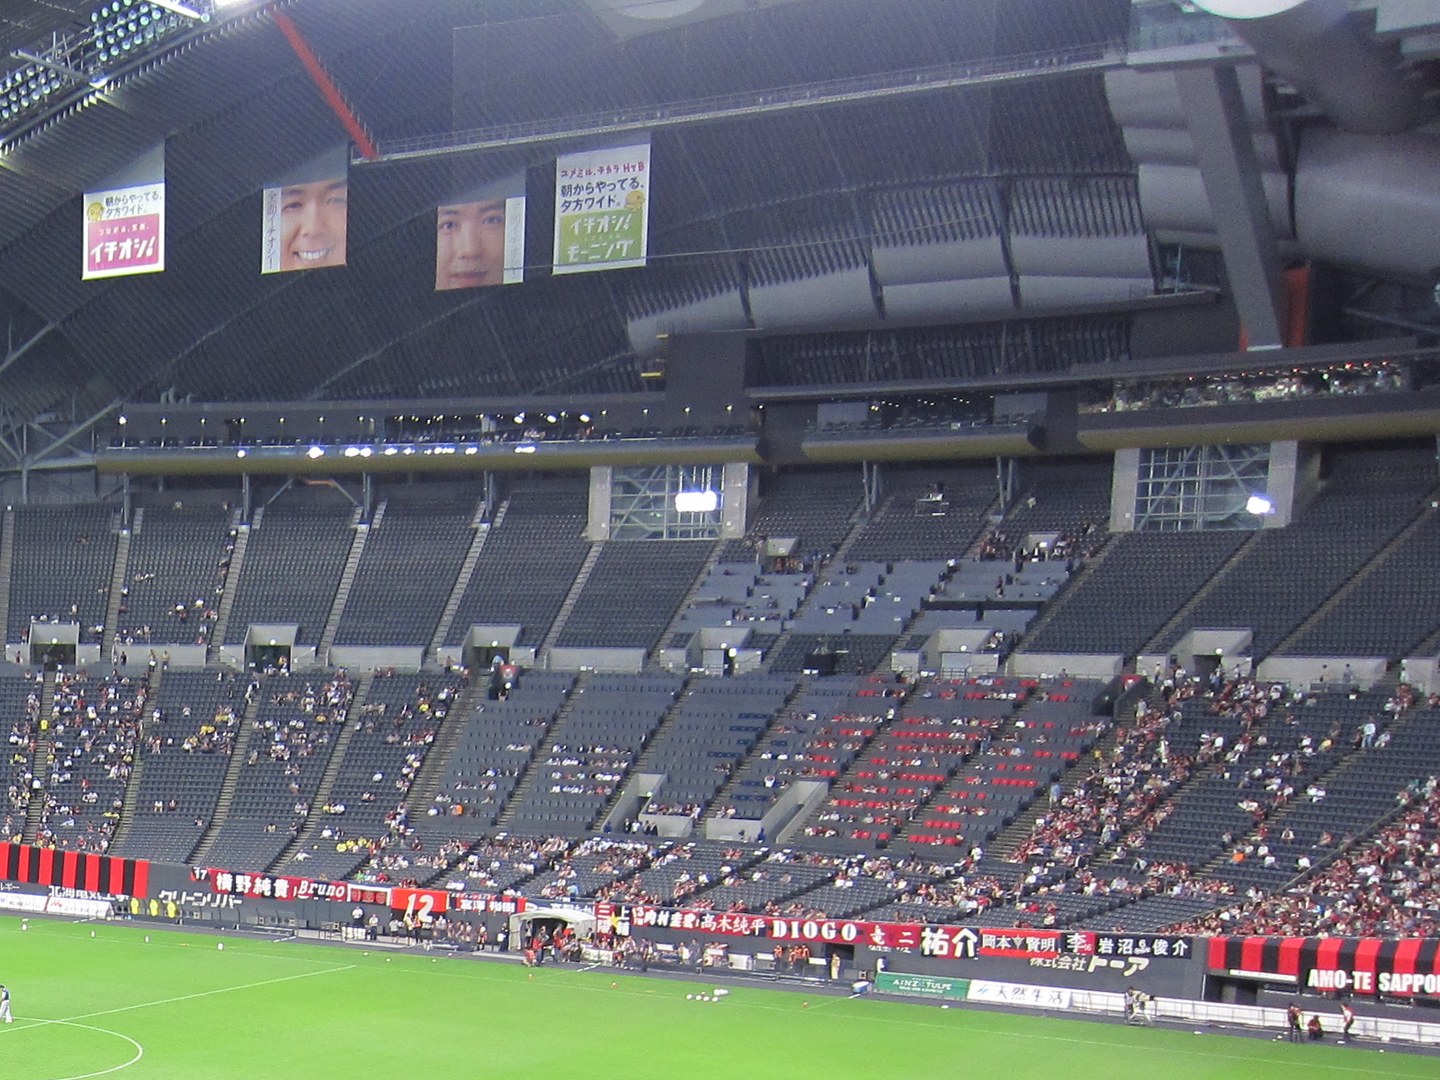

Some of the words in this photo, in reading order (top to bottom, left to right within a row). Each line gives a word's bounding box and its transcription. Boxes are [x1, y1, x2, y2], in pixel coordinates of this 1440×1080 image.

[194, 867, 208, 880] 17
[216, 872, 289, 898] 横野純貴
[298, 881, 345, 898] Bruno
[404, 892, 435, 923] 12
[702, 914, 766, 936] 高木純平
[772, 919, 857, 942] DIOGO
[921, 926, 979, 957] 祐介
[982, 934, 1011, 950] 岡本
[1025, 936, 1056, 953] 賢明
[1098, 938, 1133, 955] 岩沼
[1152, 938, 1189, 957] 俊介
[1087, 955, 1150, 977] トーア
[1307, 968, 1372, 991] AMO-TE
